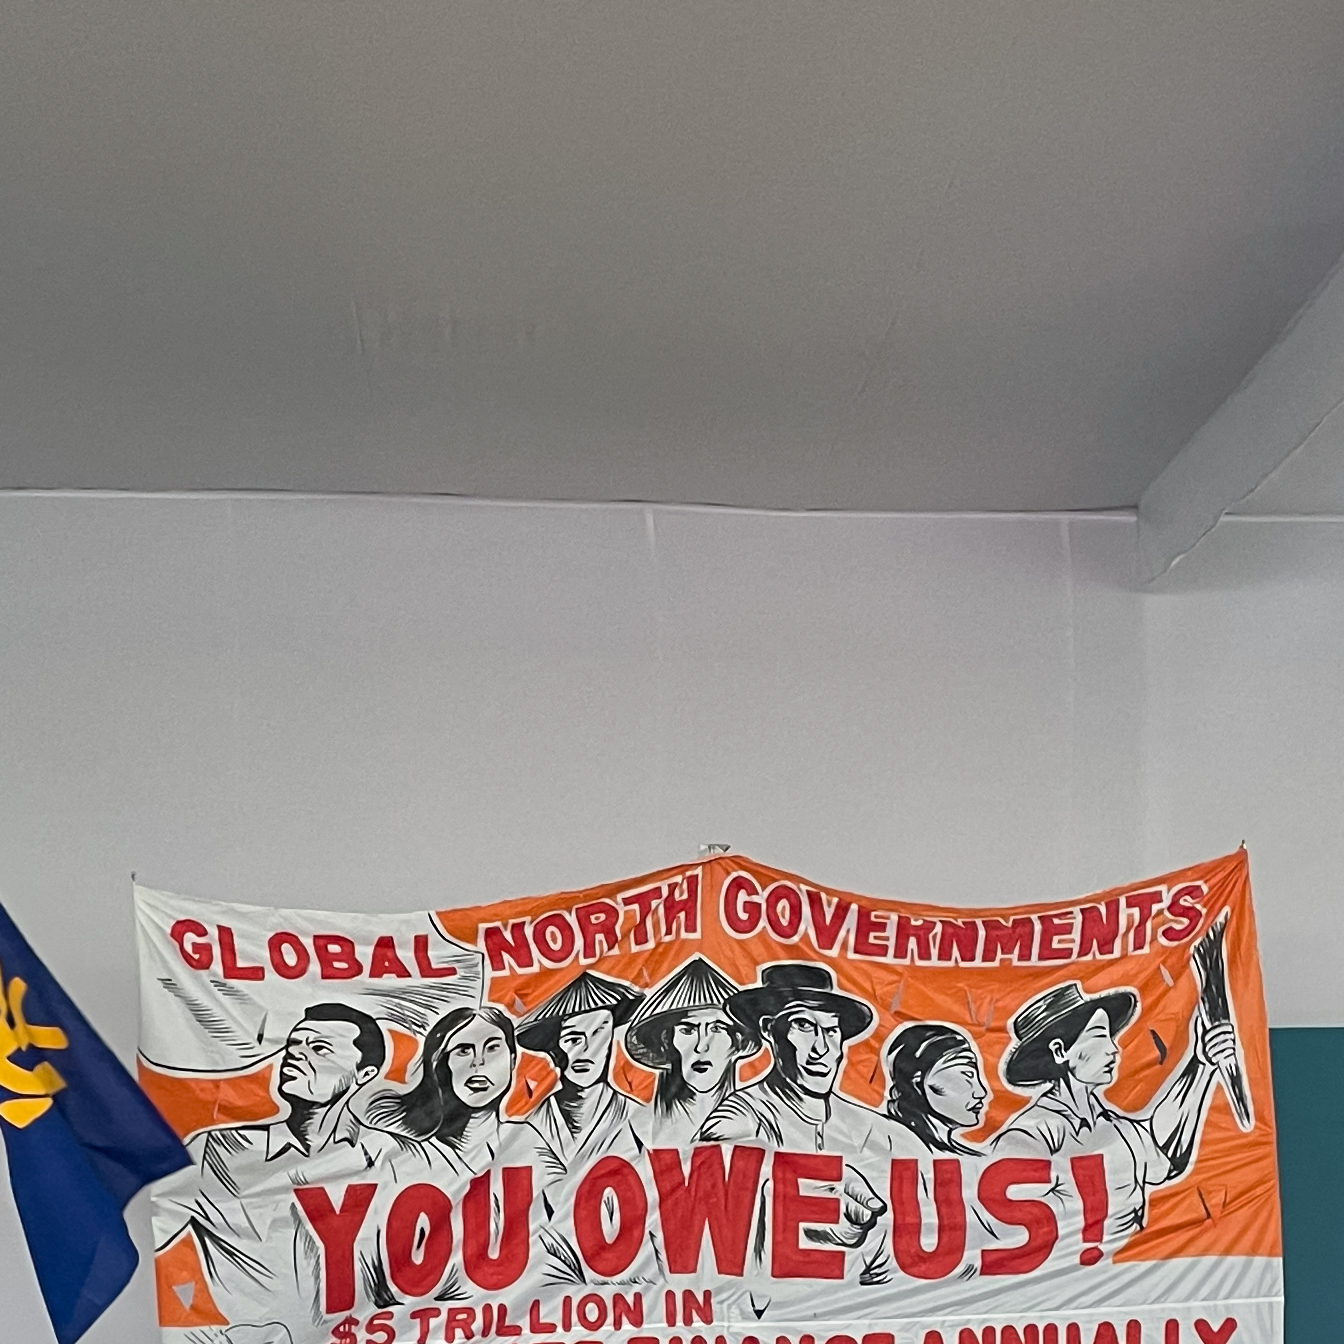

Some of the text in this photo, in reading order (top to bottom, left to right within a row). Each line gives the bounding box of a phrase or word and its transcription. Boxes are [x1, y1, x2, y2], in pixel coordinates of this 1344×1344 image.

[170, 872, 1205, 981] GLOBAL NORTH GOVERNMENTS
[294, 1144, 1109, 1314] YOU OWE US!
[409, 1291, 646, 1344] TRILLION
[665, 1289, 713, 1327] IN
